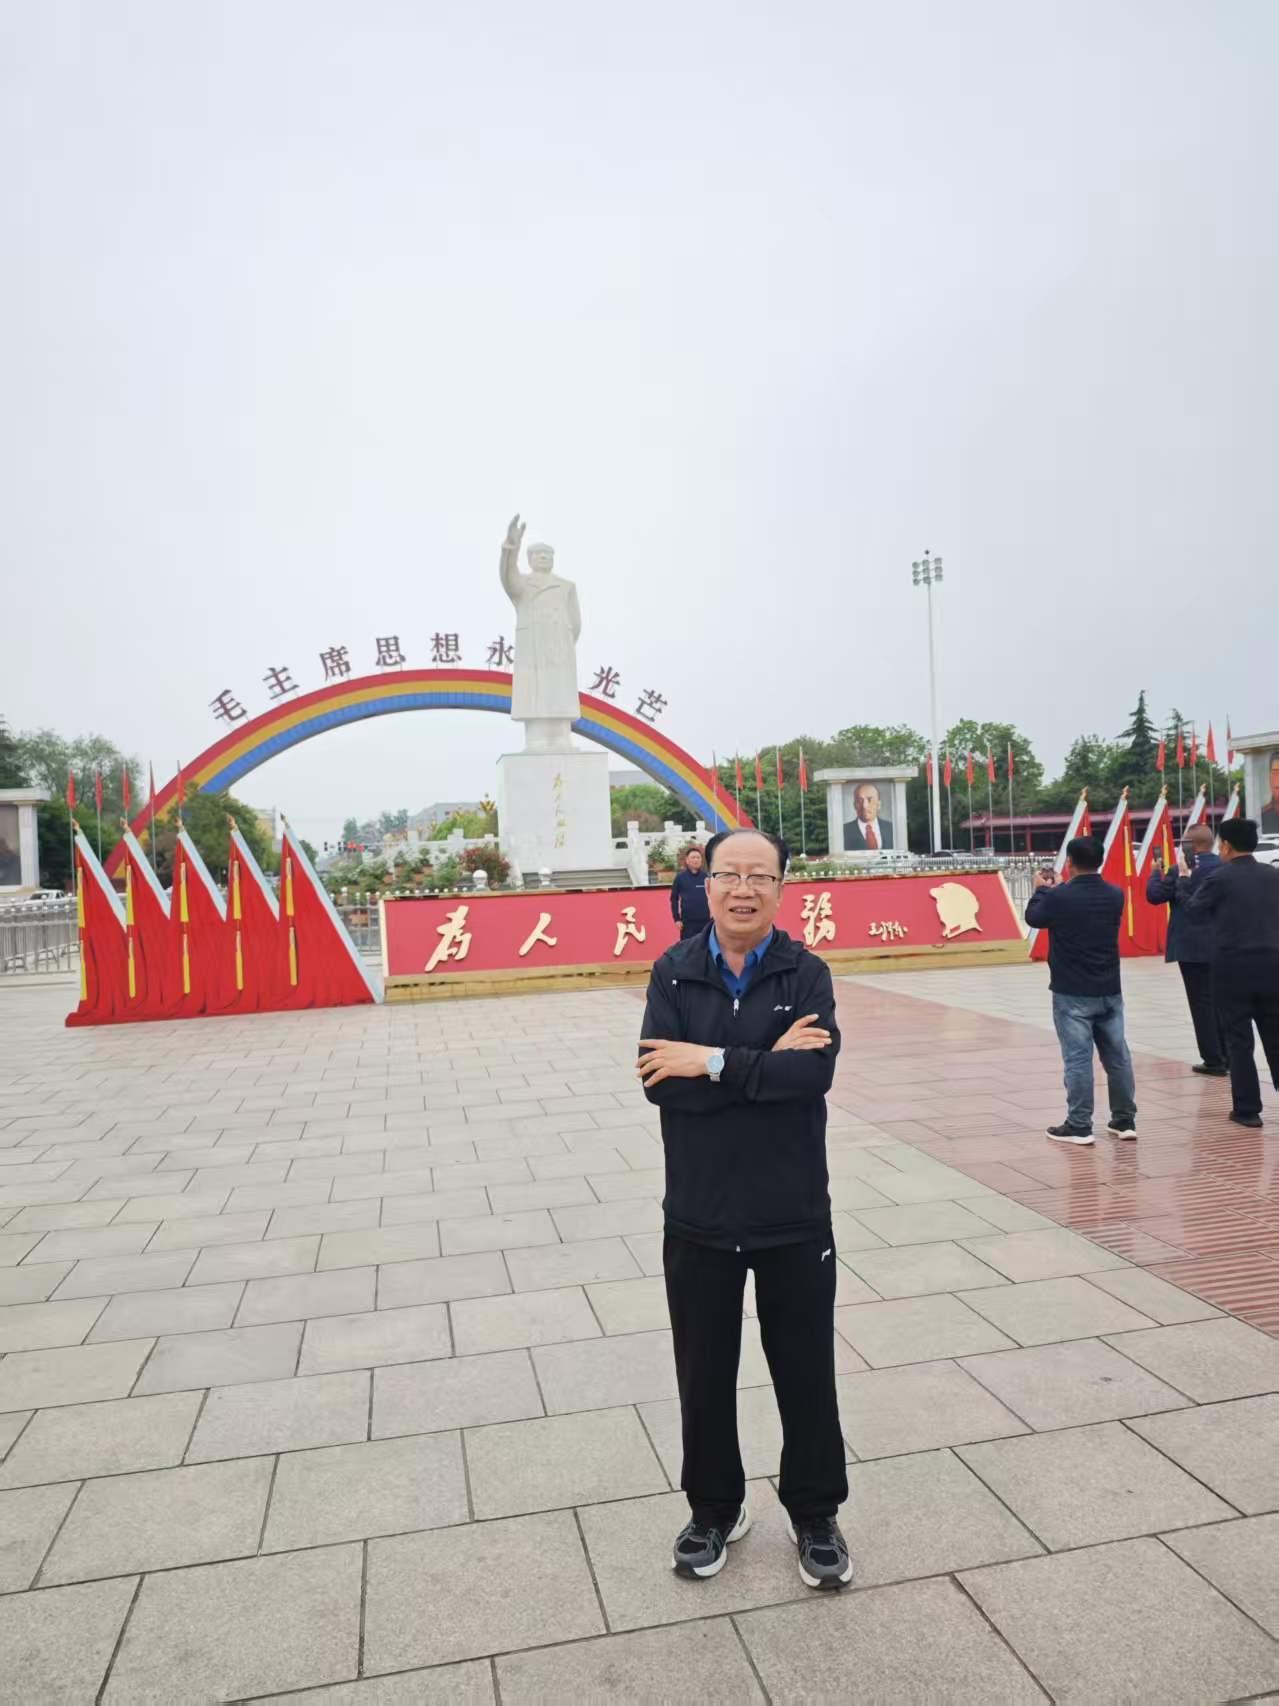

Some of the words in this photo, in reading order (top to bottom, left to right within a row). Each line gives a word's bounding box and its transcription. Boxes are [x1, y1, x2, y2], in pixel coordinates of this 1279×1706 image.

[209, 632, 668, 722] 毛主席思想永光芒
